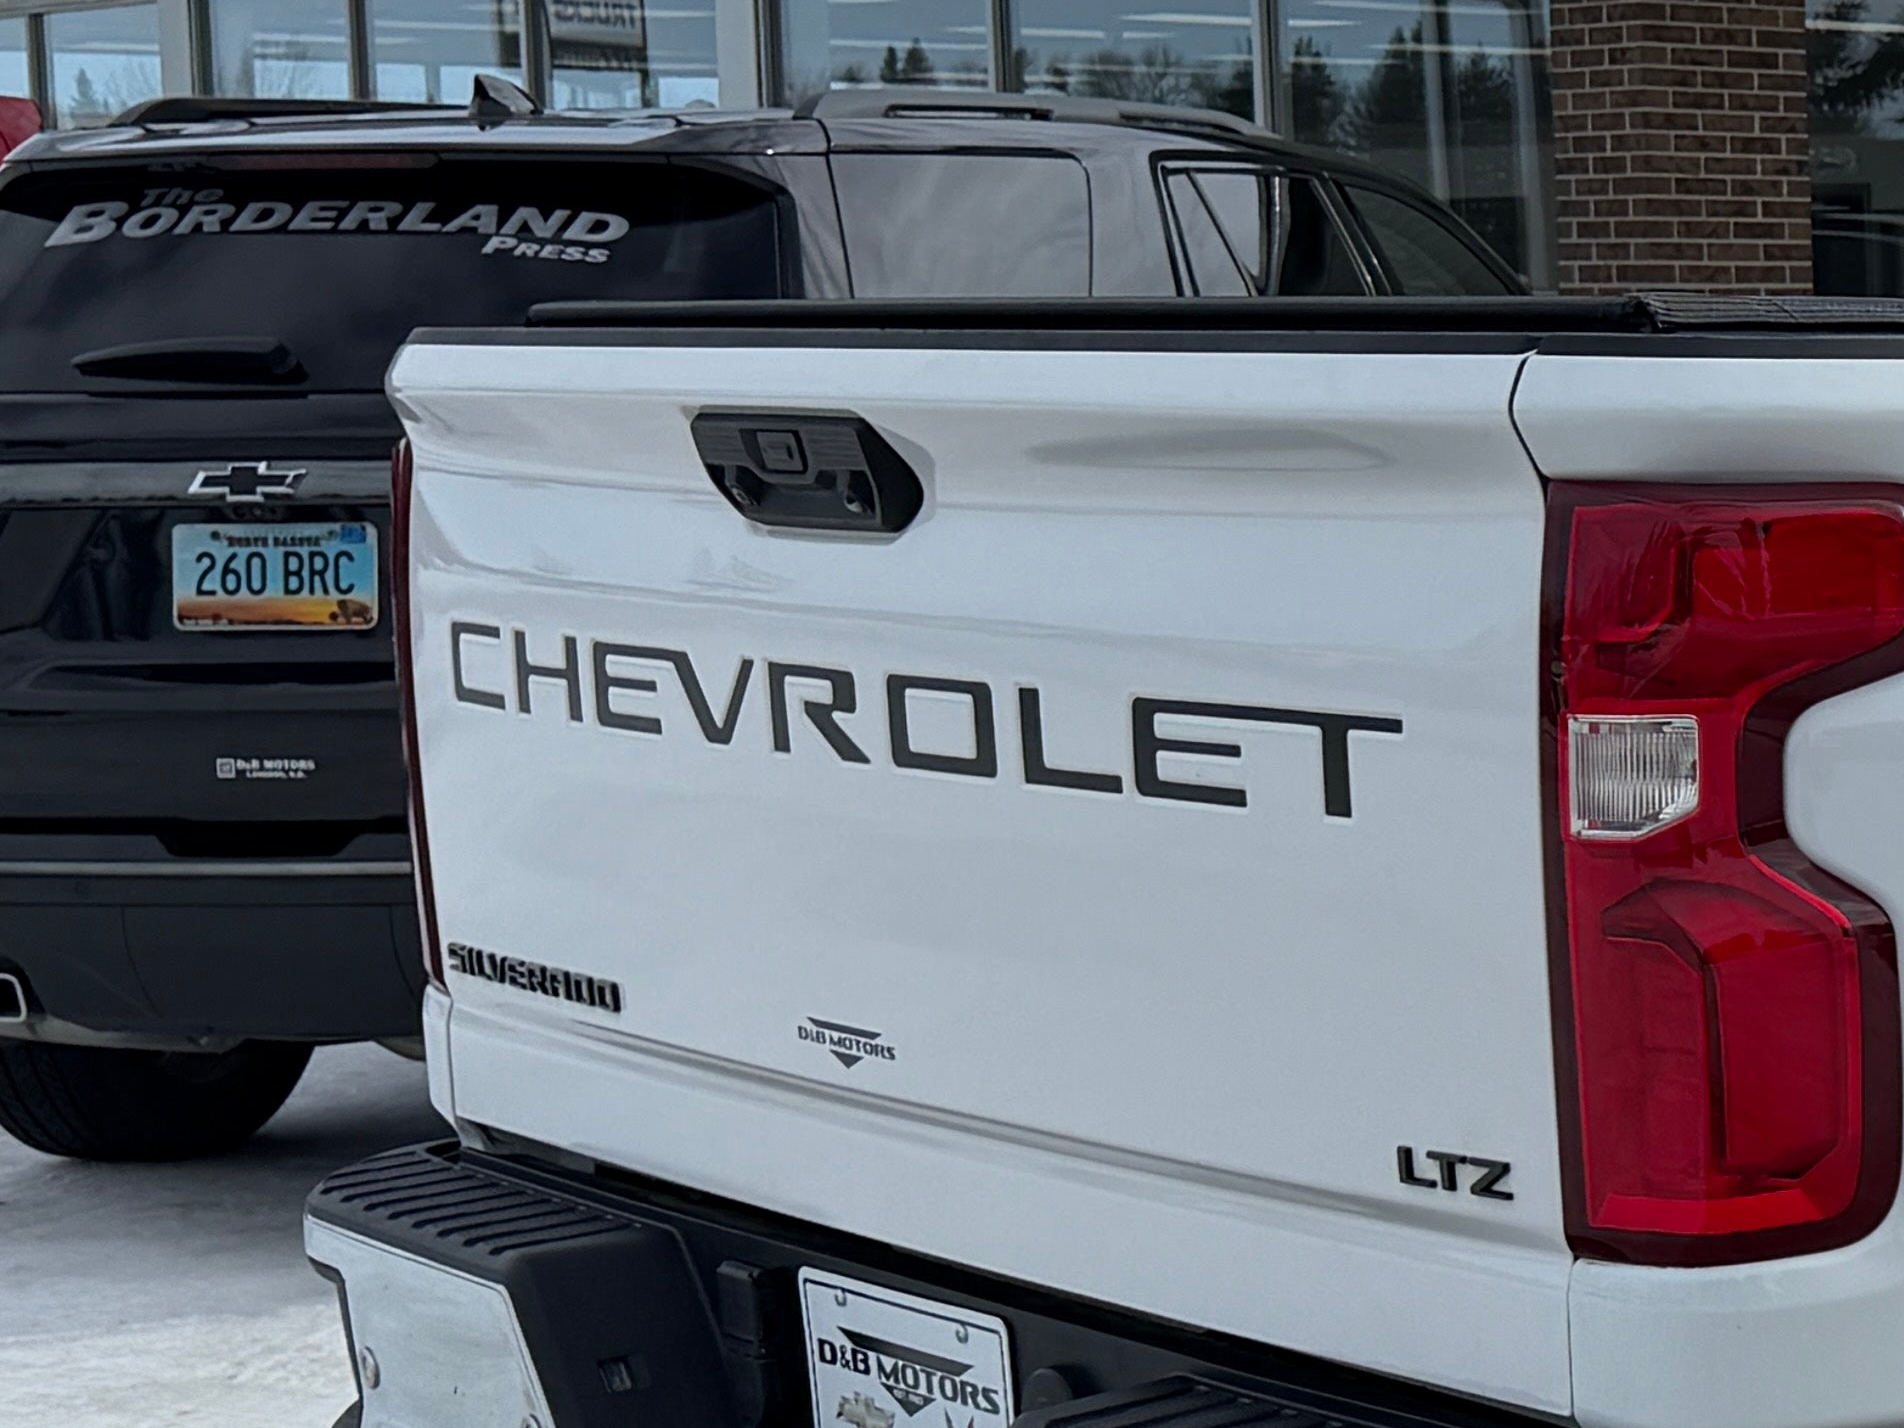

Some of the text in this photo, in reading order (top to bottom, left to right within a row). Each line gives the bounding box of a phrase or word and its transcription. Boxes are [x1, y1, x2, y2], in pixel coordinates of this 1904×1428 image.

[140, 187, 225, 207] The
[43, 199, 631, 248] BORDERLAND
[480, 236, 611, 263] PRESS
[195, 551, 356, 596] 260 BRC
[450, 620, 1405, 818] CHEVROLET
[447, 942, 622, 1013] SILVERADO
[828, 1033, 896, 1061] MOTORS
[1396, 1145, 1514, 1201] LTZ
[817, 1337, 1000, 1415] D&B MOTORS
